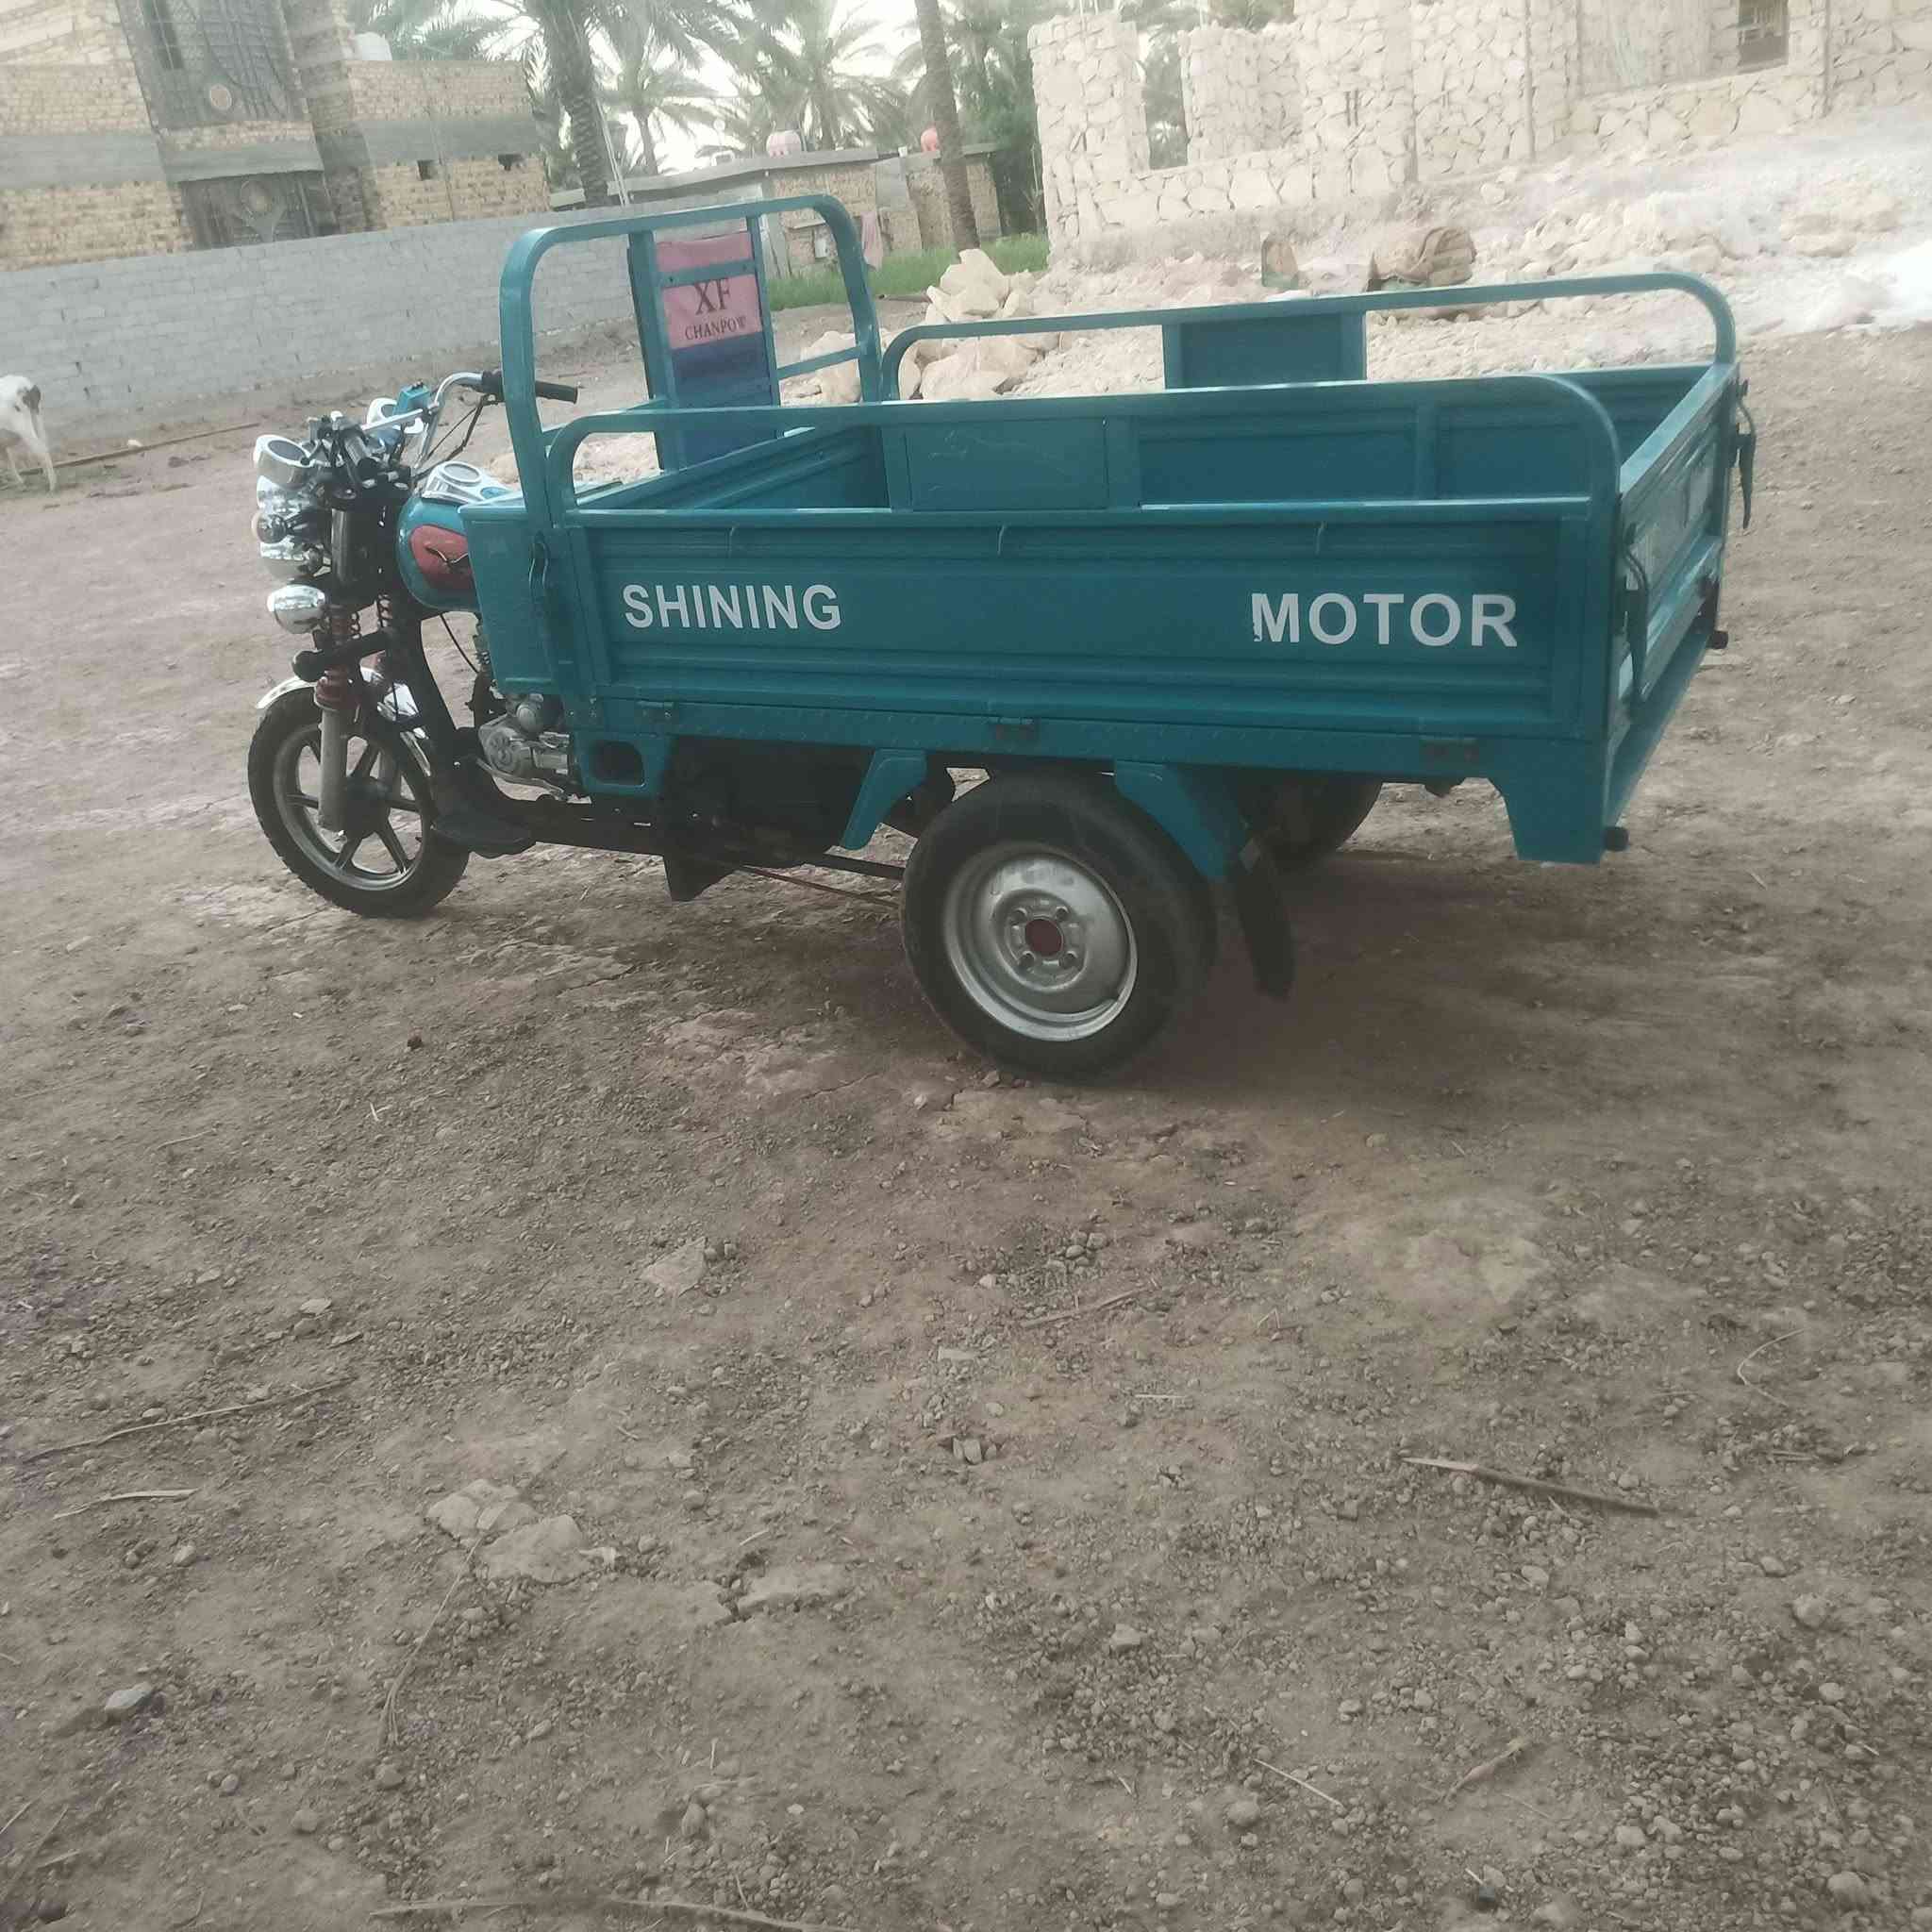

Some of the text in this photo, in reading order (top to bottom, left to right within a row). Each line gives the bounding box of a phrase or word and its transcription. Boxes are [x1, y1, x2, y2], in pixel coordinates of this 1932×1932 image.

[693, 277, 731, 315] XF
[623, 584, 1518, 647] SHINING MOTOR
